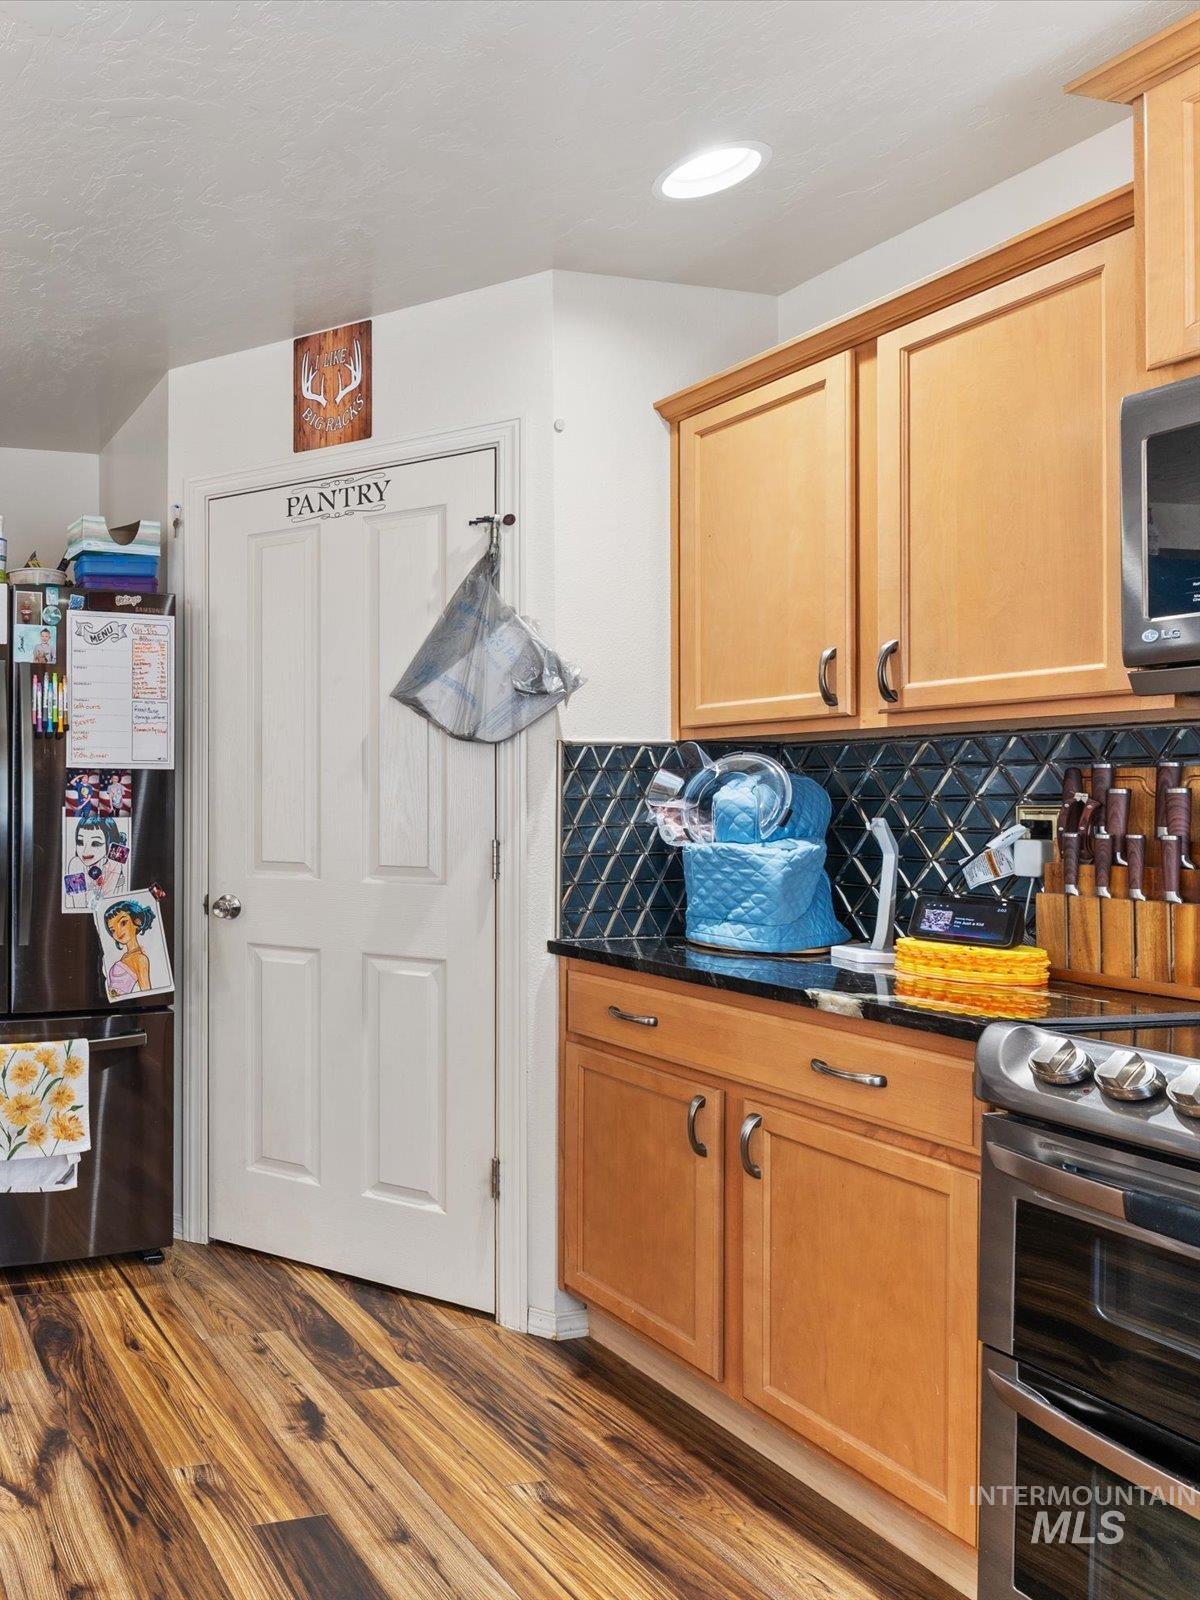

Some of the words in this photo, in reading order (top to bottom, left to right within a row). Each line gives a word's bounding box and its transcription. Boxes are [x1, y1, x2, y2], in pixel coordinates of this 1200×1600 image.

[315, 355, 320, 369] I
[323, 348, 347, 368] LIKE
[302, 407, 325, 431] BIG
[325, 393, 364, 432] RACKS
[286, 479, 391, 518] PANTRY
[89, 626, 114, 643] MENU
[1161, 629, 1181, 640] LG
